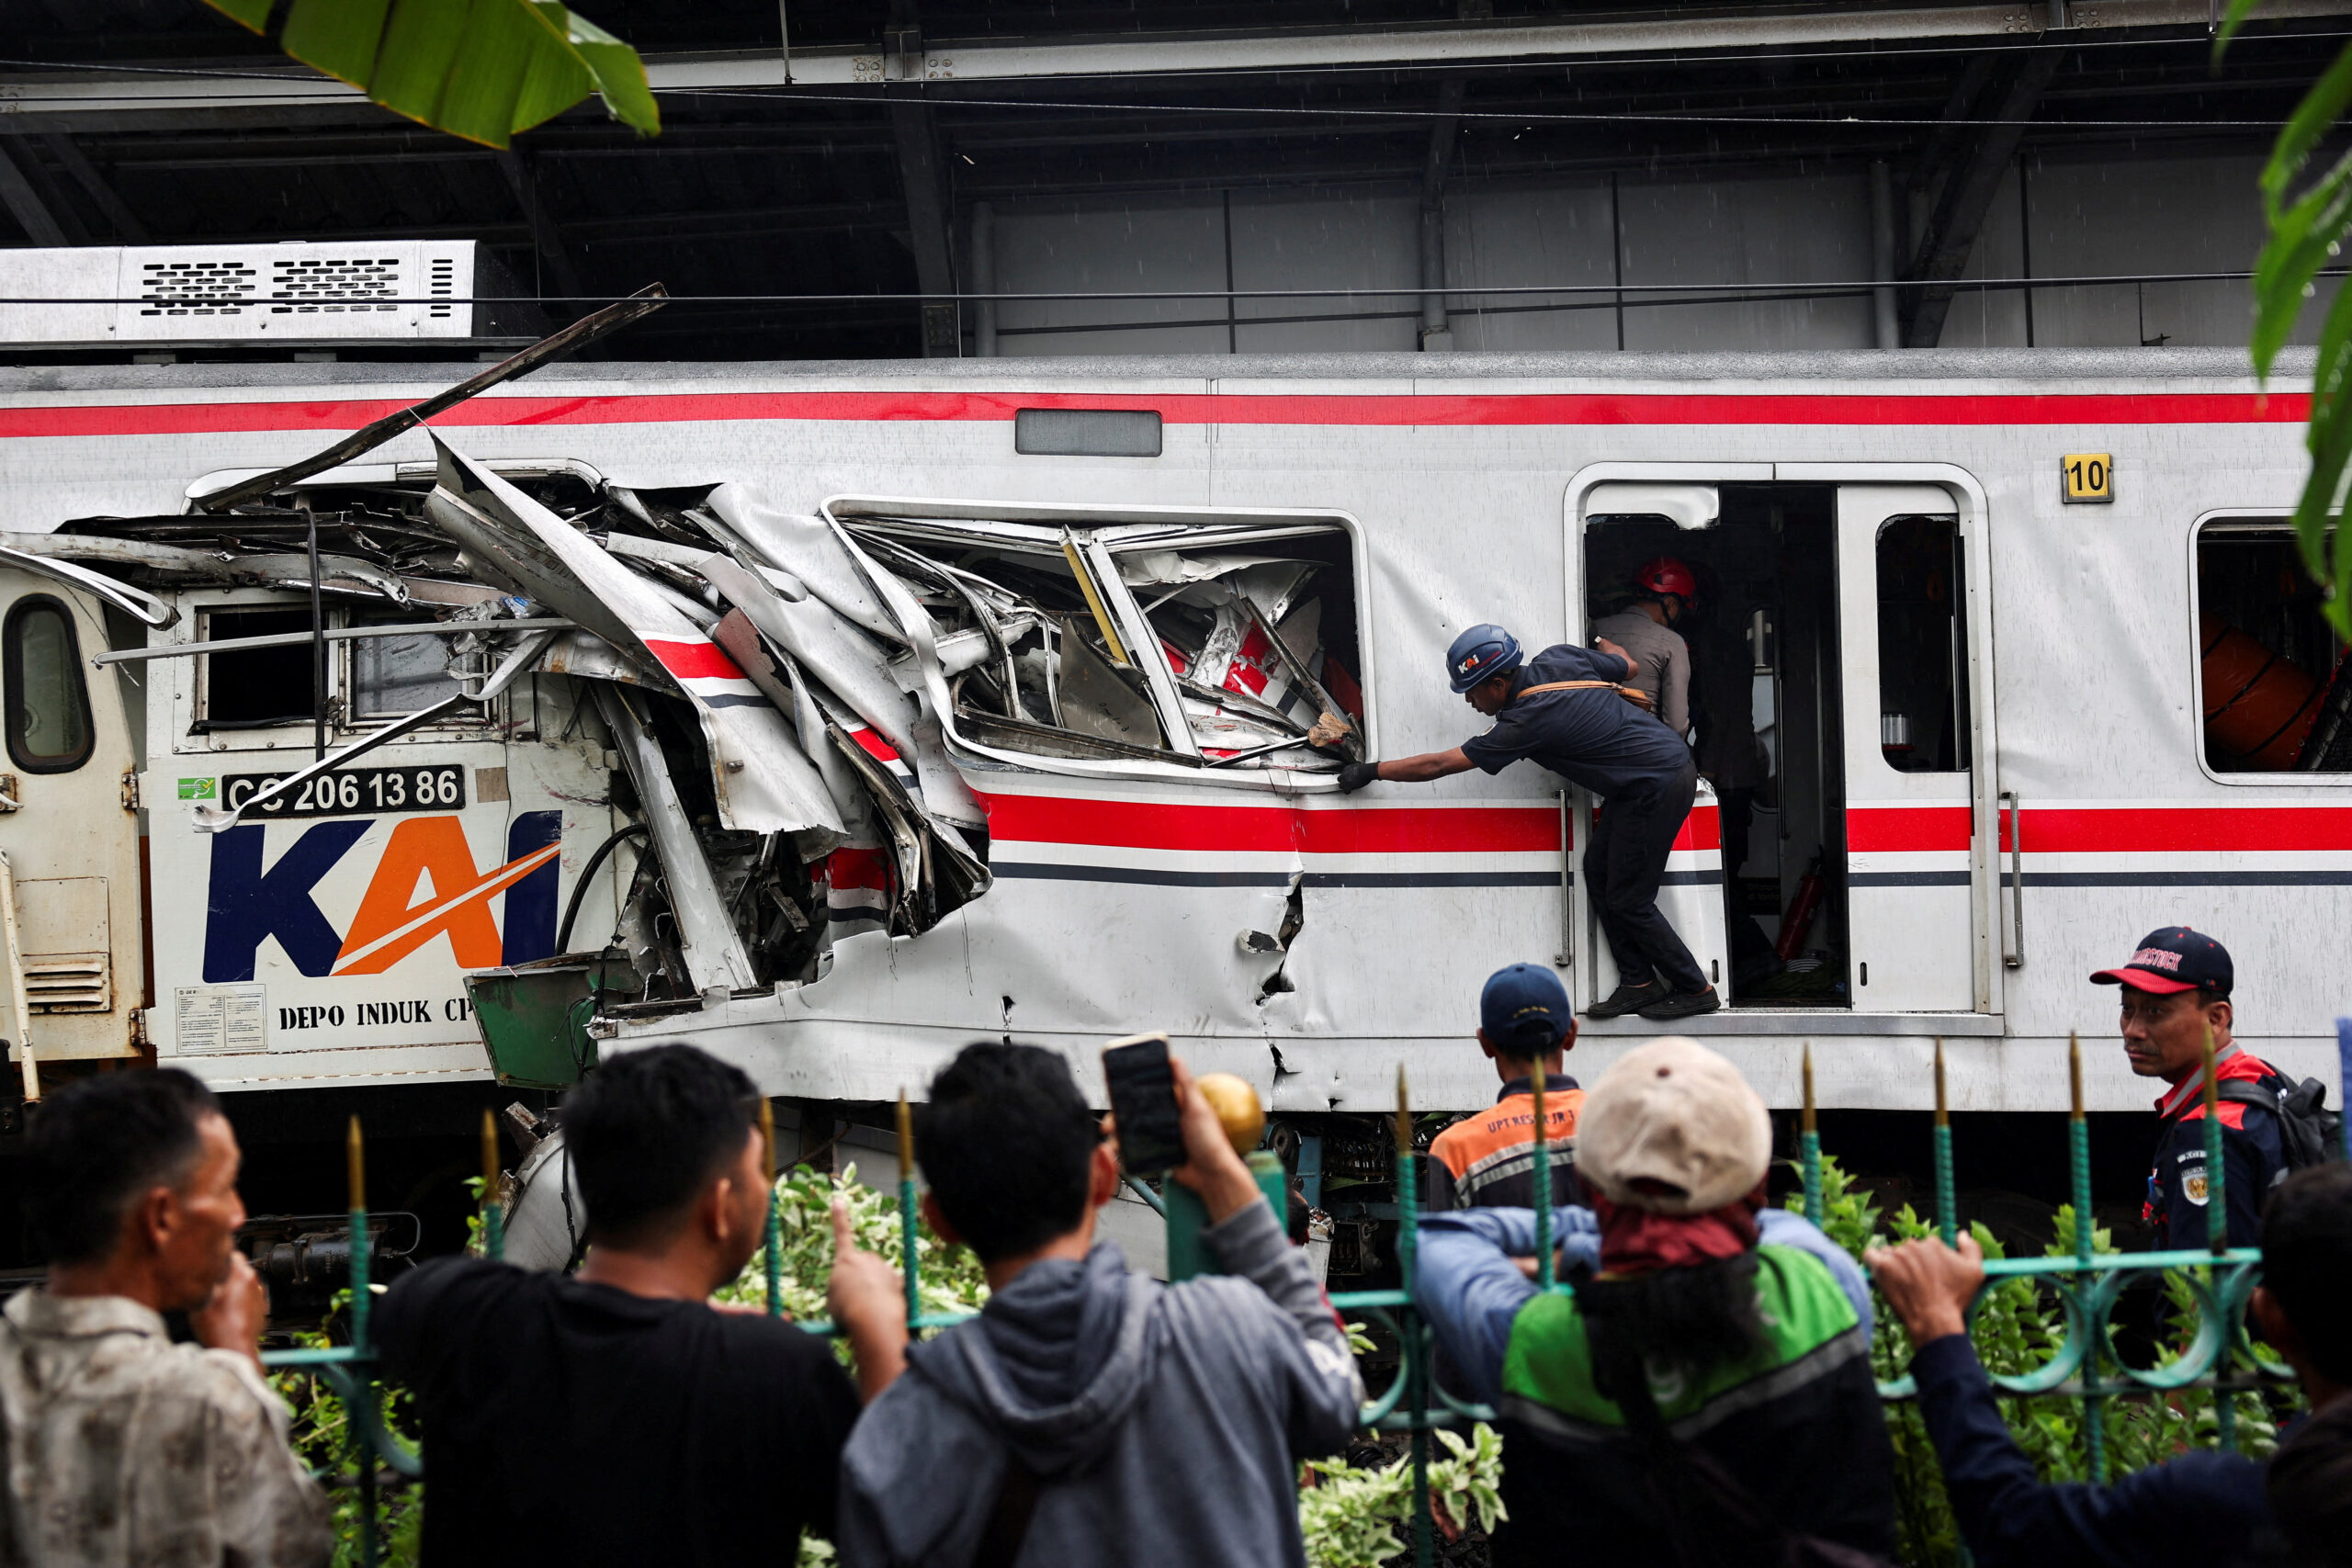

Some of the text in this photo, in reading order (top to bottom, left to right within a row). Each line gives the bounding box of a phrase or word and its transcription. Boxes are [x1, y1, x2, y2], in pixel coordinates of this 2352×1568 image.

[2071, 460, 2104, 491] 10
[1458, 654, 1479, 674] KAI
[294, 774, 359, 810] 206
[368, 773, 406, 807] 13
[415, 770, 458, 805] 86
[202, 809, 563, 983] KAI
[279, 1005, 345, 1031] DEPO
[356, 1000, 433, 1026] INDUK
[1487, 1118, 1510, 1134] UPT
[1512, 1114, 1550, 1126] RESR
